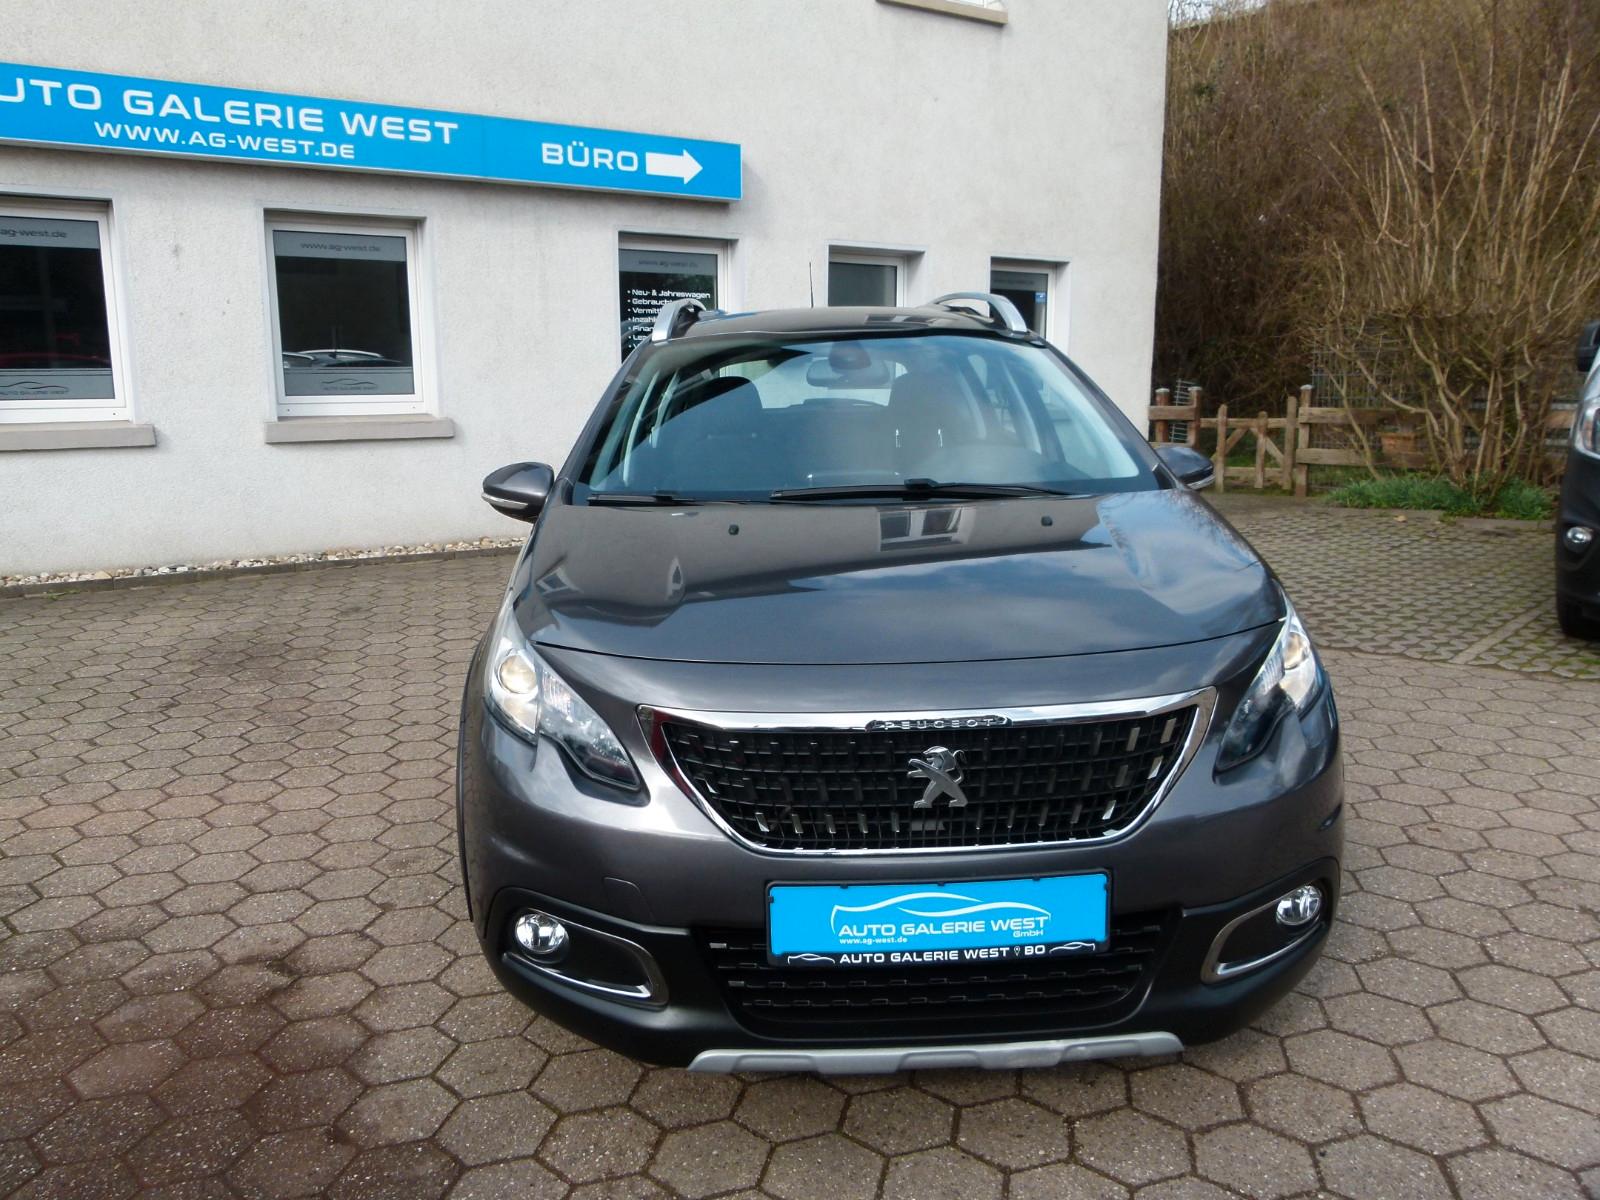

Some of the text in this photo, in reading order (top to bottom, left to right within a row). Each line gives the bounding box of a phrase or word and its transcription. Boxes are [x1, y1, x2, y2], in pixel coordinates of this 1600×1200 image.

[123, 89, 325, 133] GALERIE
[340, 111, 458, 144] WEST
[94, 120, 356, 159] WWW.AG-WEST.DE
[541, 140, 639, 173] BÜRO
[658, 289, 711, 300] Jahreswagen
[883, 718, 994, 731] PEUGEOT
[838, 915, 1049, 937] AUTO GALERIE WEST
[1012, 929, 1044, 938] GmbH
[839, 936, 908, 945] www.ag-west.de
[839, 944, 1046, 964] AUTO GALERIE WEST BO
